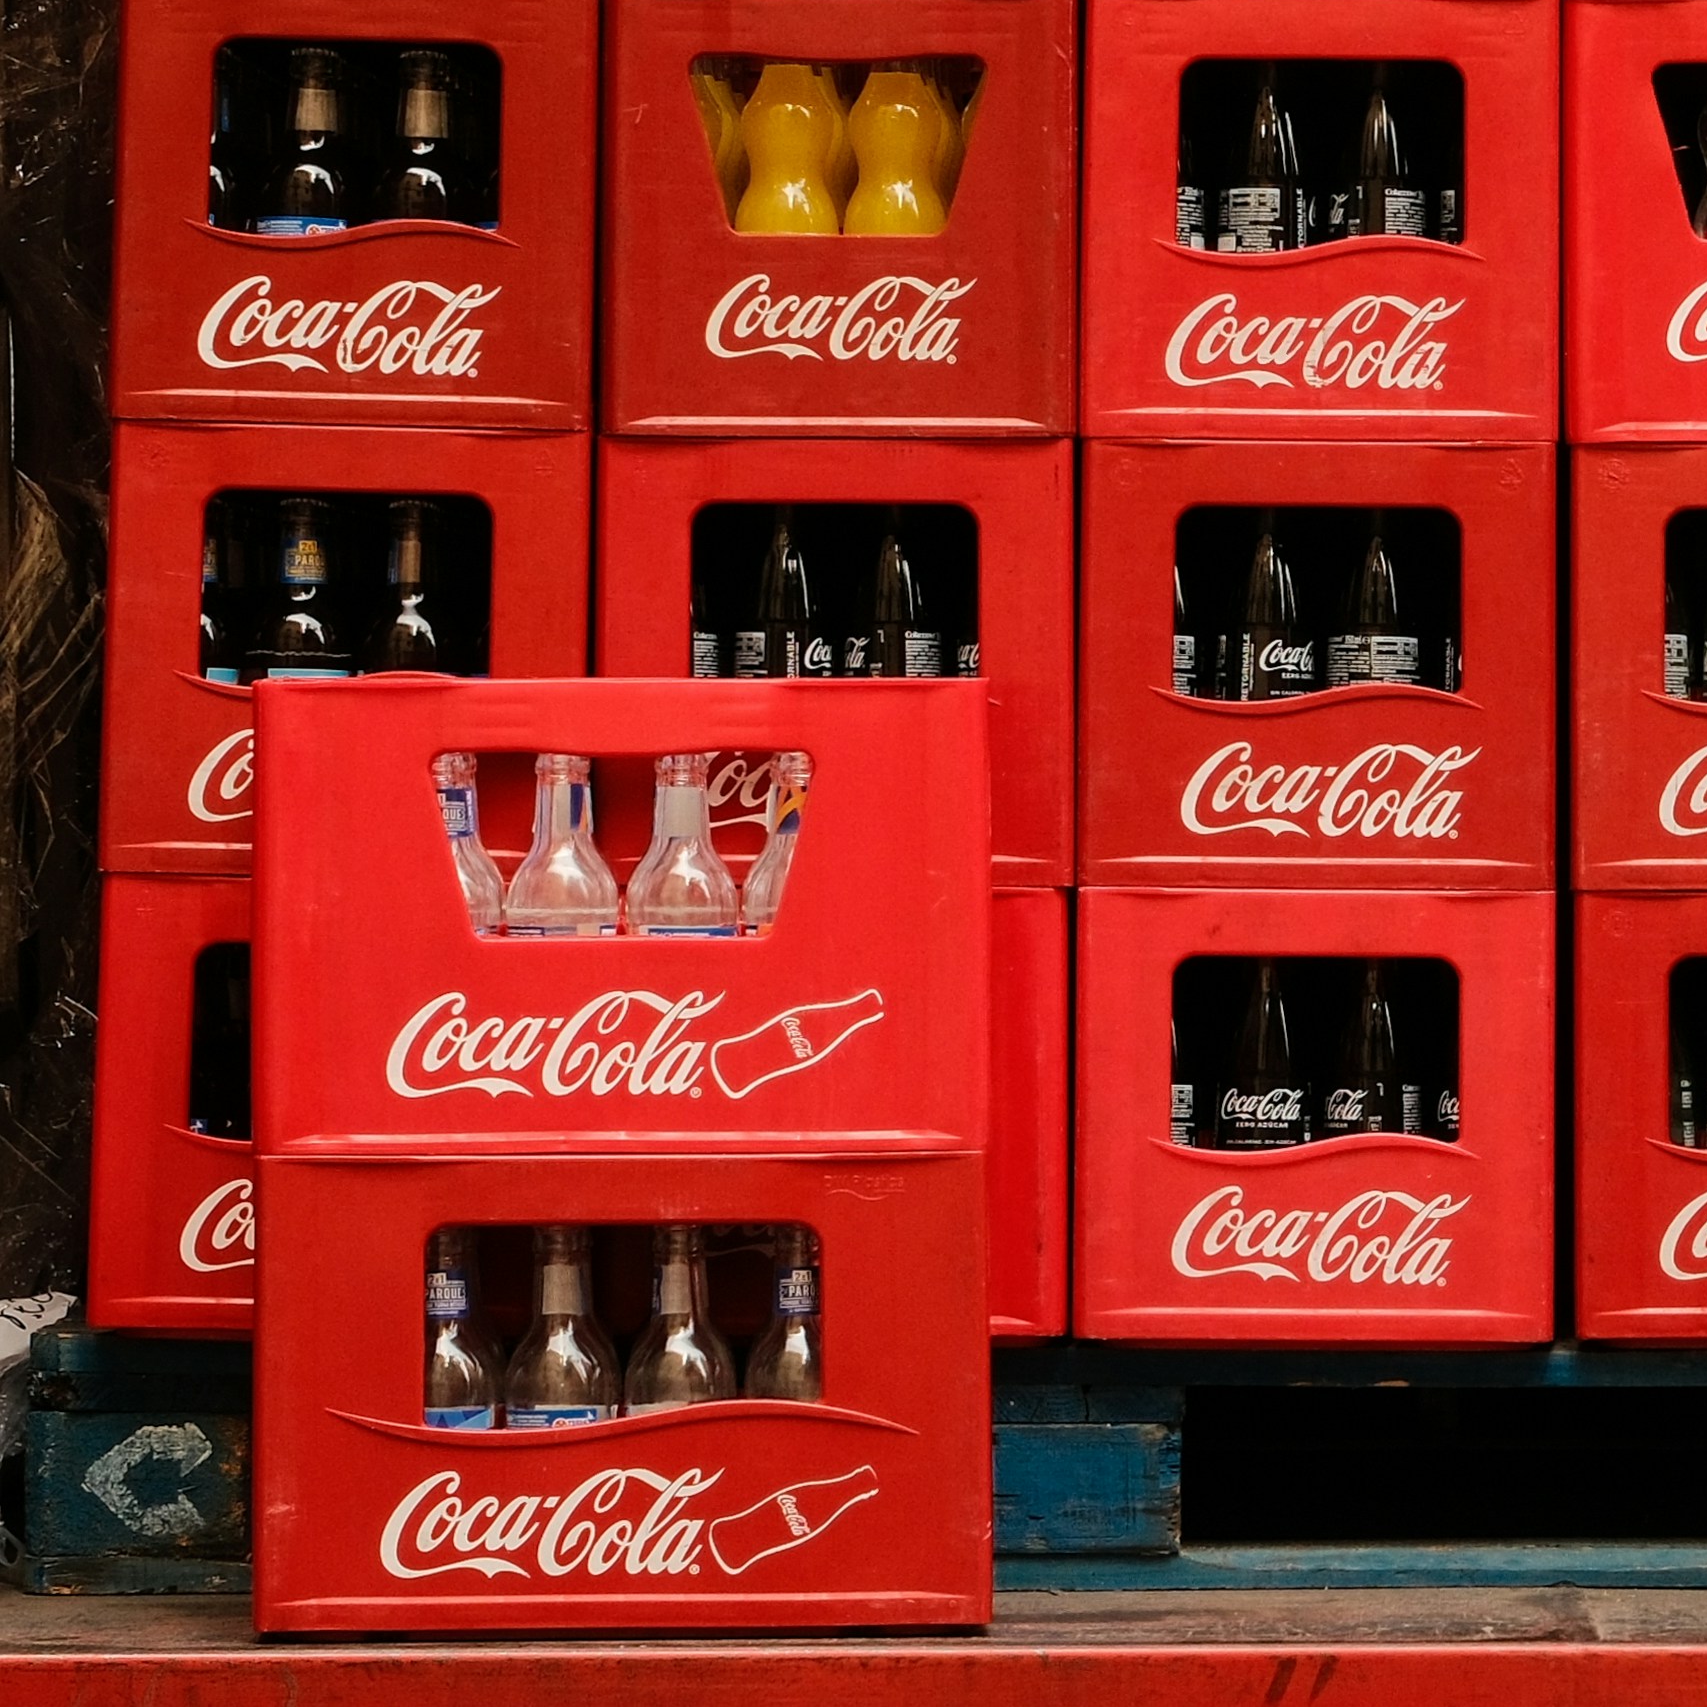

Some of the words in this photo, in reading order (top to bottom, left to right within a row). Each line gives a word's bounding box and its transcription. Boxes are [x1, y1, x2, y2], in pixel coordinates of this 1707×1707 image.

[198, 276, 501, 377] Coca-Cola
[706, 274, 976, 364] Coca-Cola
[1165, 294, 1464, 389] Coca-Cola
[1181, 742, 1480, 838] Coca-Cola
[386, 991, 726, 1098] Coca-Cola
[1221, 1087, 1304, 1121] Coca-Cola
[1171, 1186, 1470, 1286] Coca-Cola
[380, 1468, 726, 1576] Coca-Cola
